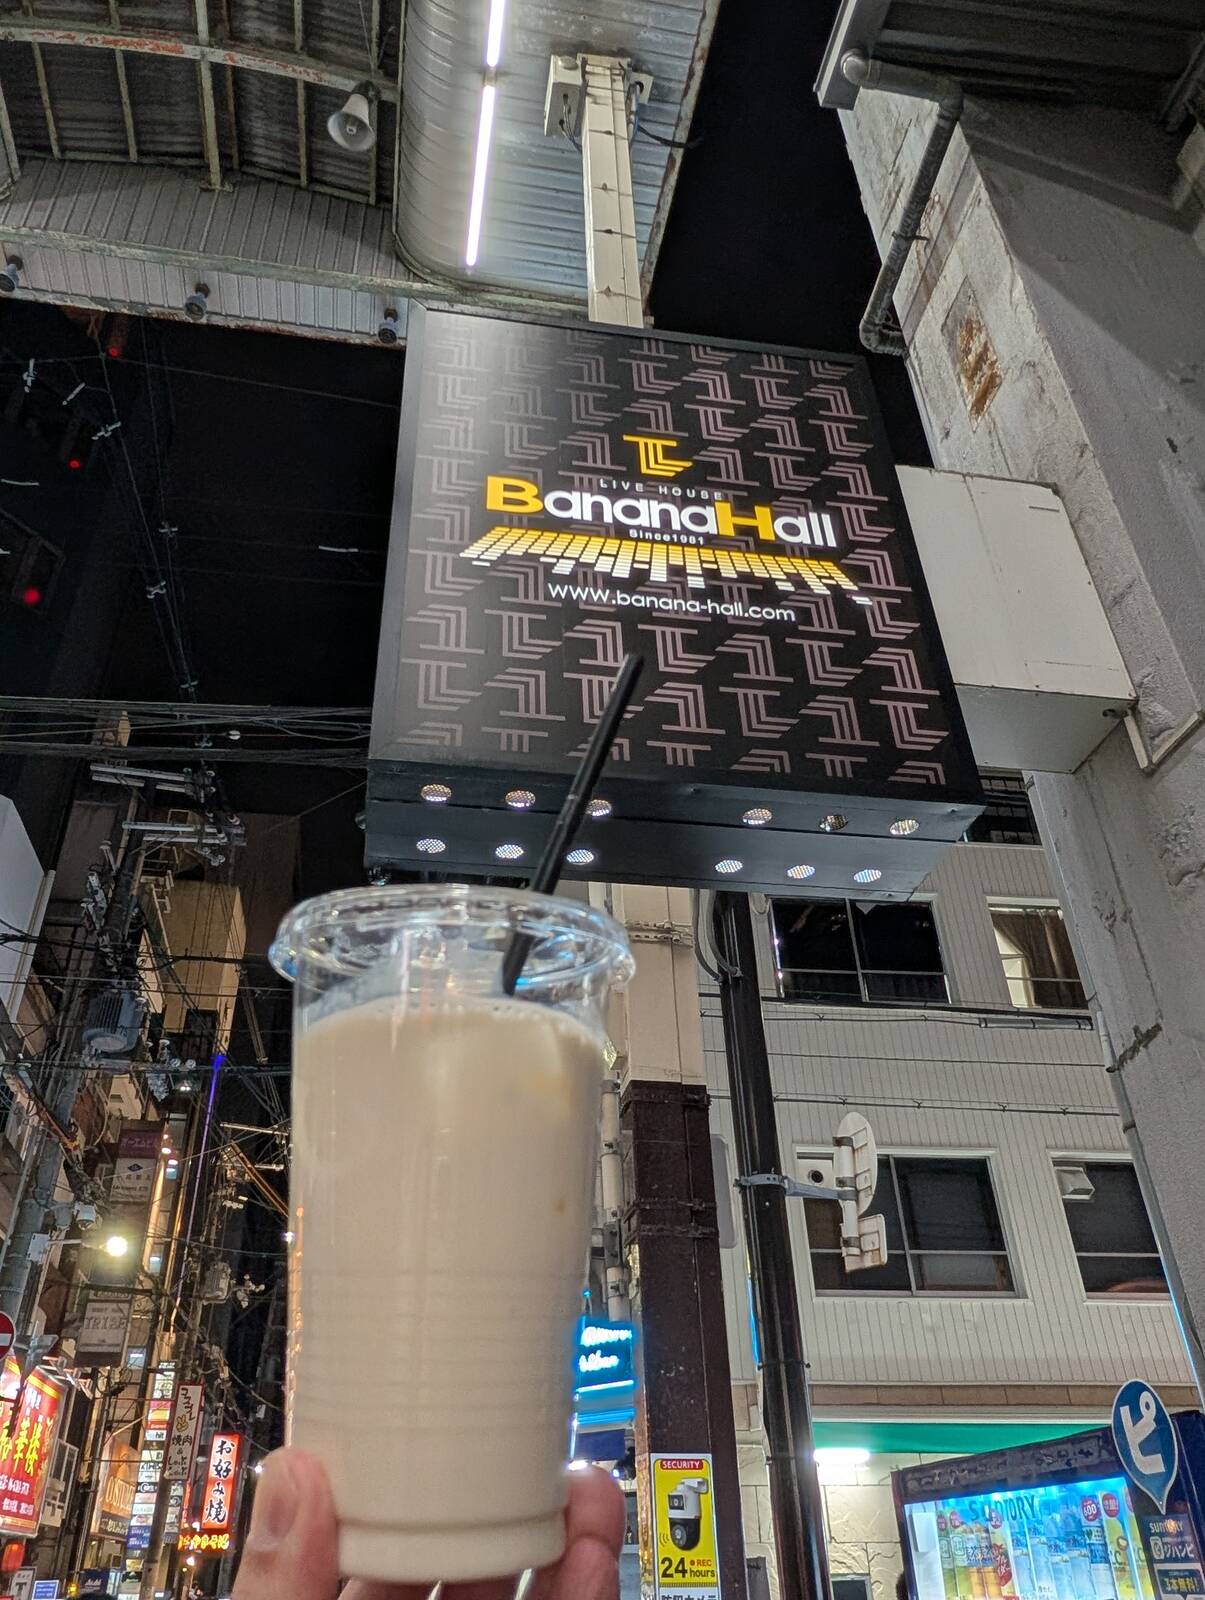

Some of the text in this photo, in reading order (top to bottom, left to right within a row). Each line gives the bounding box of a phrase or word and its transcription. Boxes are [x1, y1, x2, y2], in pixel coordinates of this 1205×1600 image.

[599, 478, 723, 501] LIVE HOUSE
[486, 475, 837, 548] BananaHall
[548, 583, 797, 622] www.banana-hall.com
[662, 1460, 701, 1470] SECURITY
[660, 1556, 716, 1579] 24 hours
[696, 1559, 712, 1567] REC
